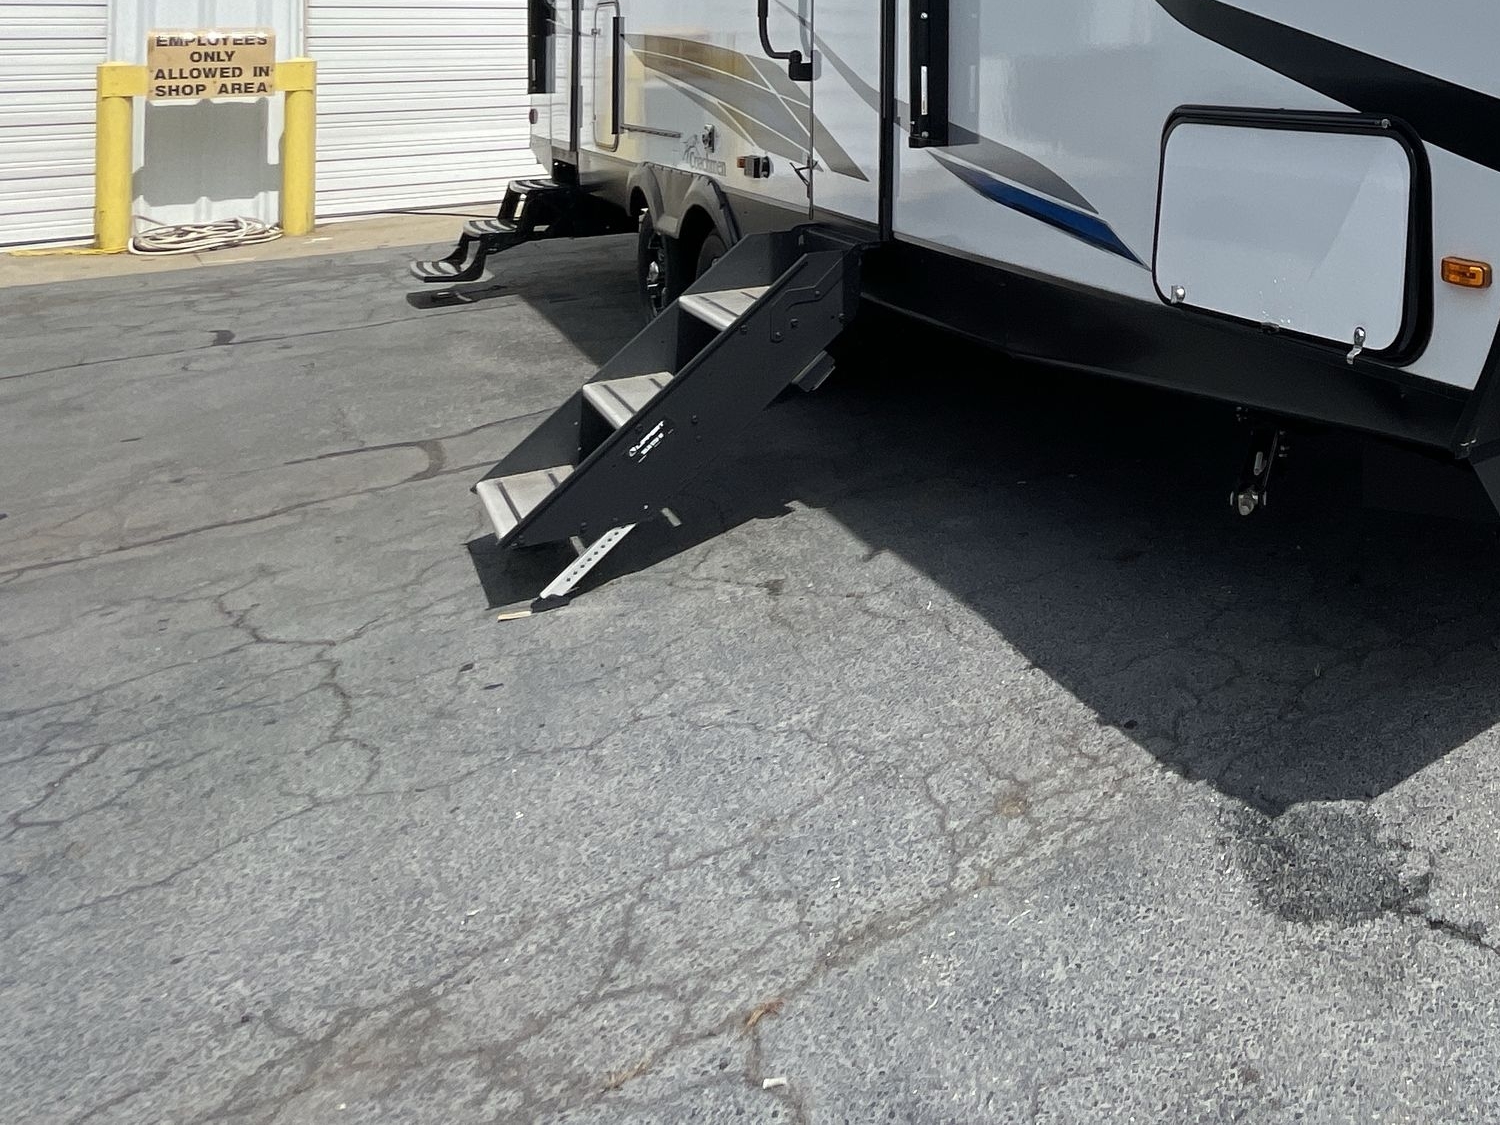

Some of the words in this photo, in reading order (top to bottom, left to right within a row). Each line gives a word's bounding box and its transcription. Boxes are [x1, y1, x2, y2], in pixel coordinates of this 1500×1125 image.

[189, 50, 236, 63] ONLY
[154, 66, 244, 80] ALLOWED
[253, 65, 270, 77] IN
[155, 83, 207, 96] SHOP
[217, 81, 268, 94] AREA
